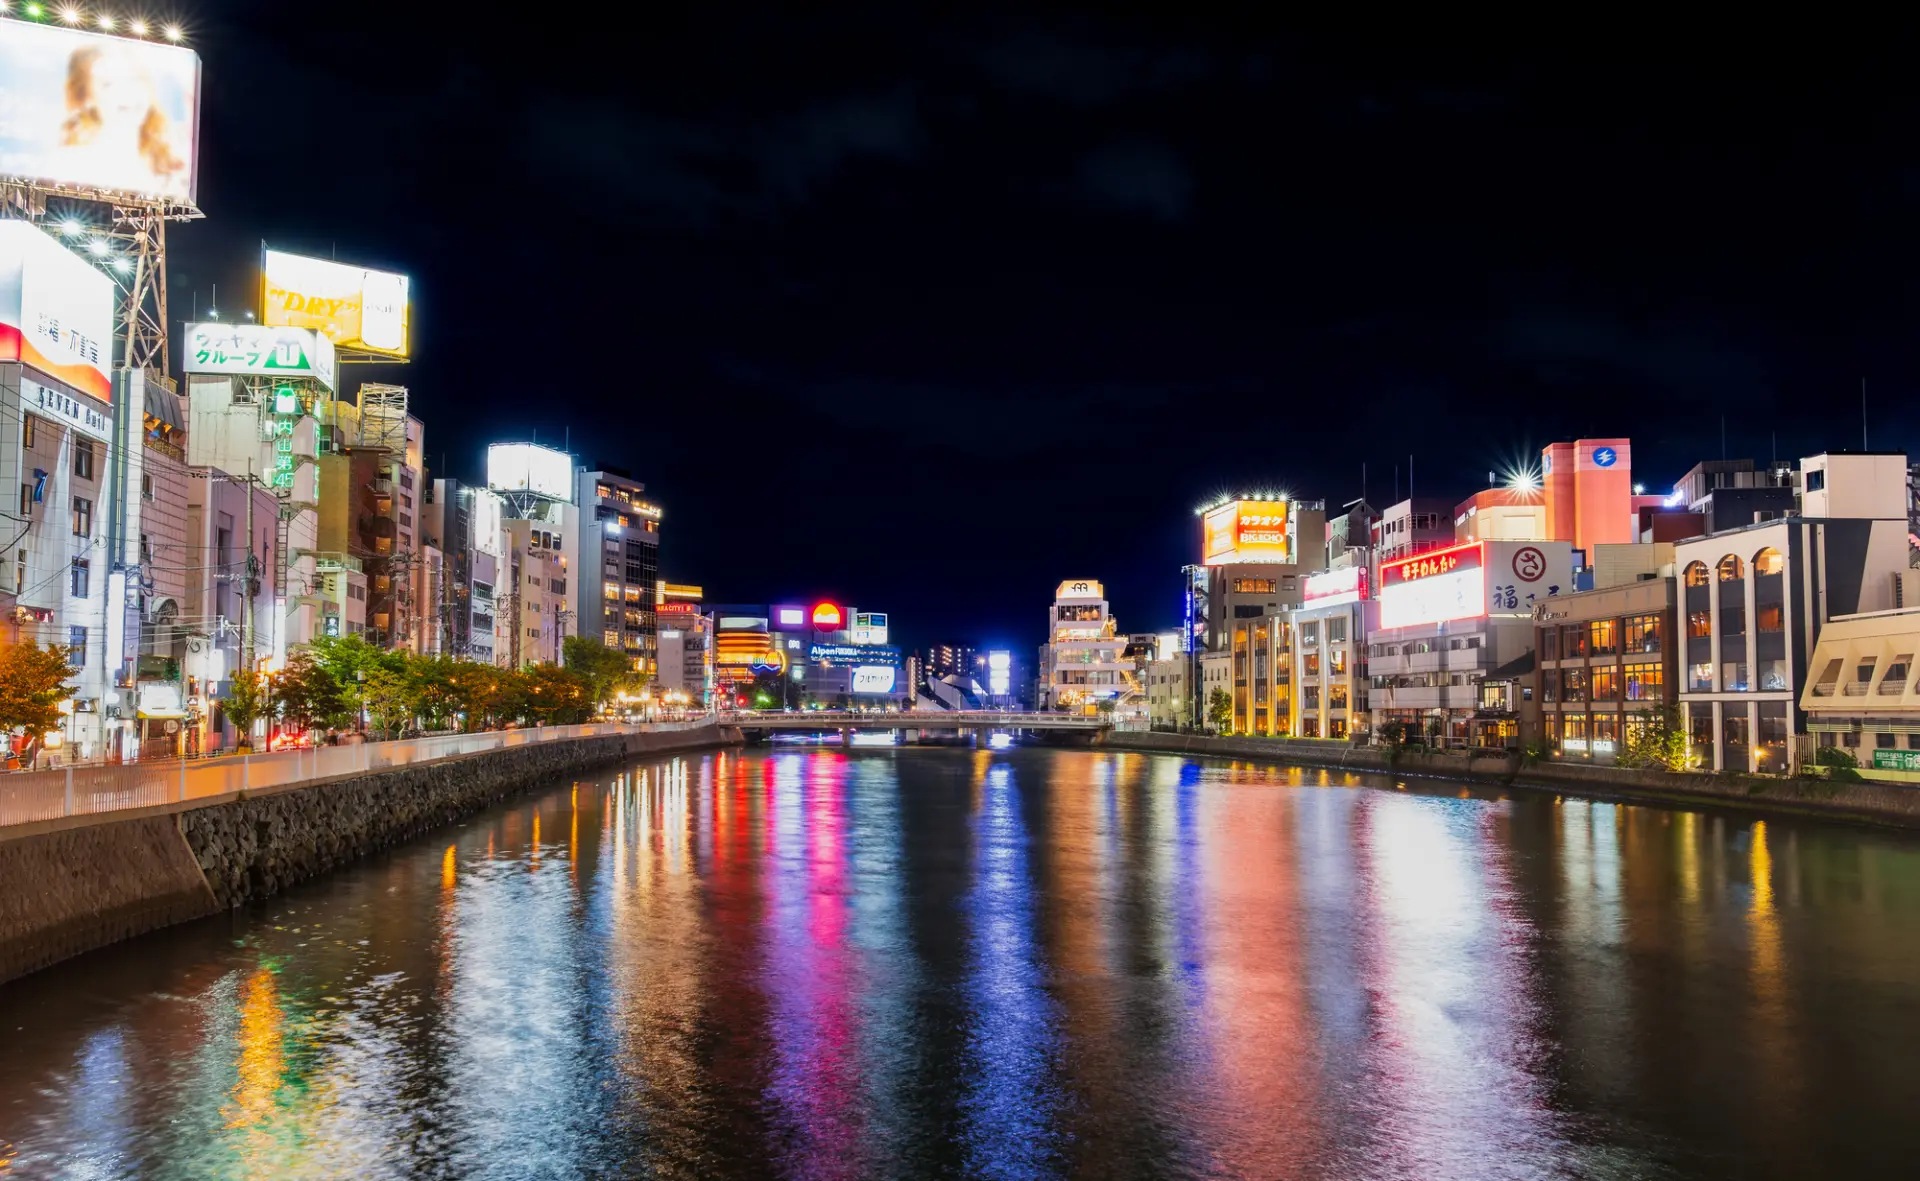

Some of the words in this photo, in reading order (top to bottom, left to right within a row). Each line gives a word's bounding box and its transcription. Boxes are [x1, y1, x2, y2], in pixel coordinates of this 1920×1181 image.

[38, 387, 80, 420] SEVEN
[1240, 515, 1284, 526] カラオケ
[1240, 533, 1258, 543] BIG
[811, 646, 836, 657] Alpen
